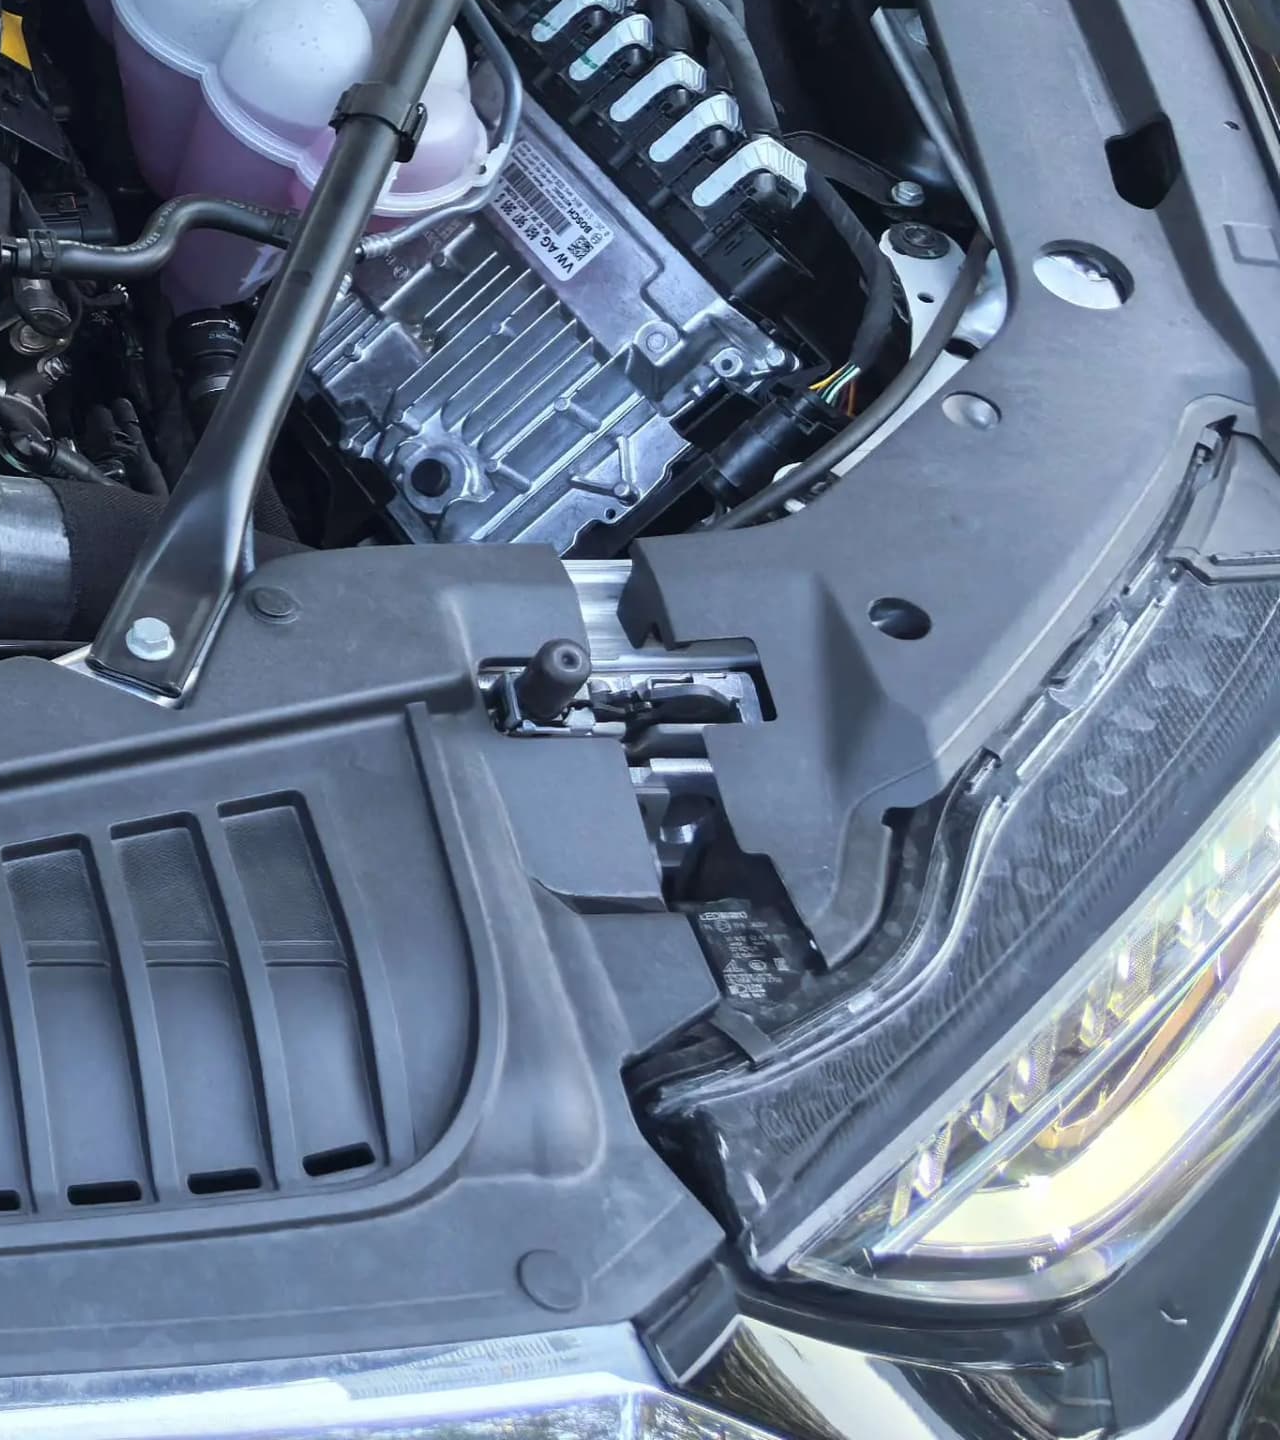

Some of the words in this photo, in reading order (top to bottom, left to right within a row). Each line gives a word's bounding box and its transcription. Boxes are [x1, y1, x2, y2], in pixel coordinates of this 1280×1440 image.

[566, 208, 593, 234] BOSCH
[540, 236, 560, 253] AG
[553, 252, 574, 274] VW
